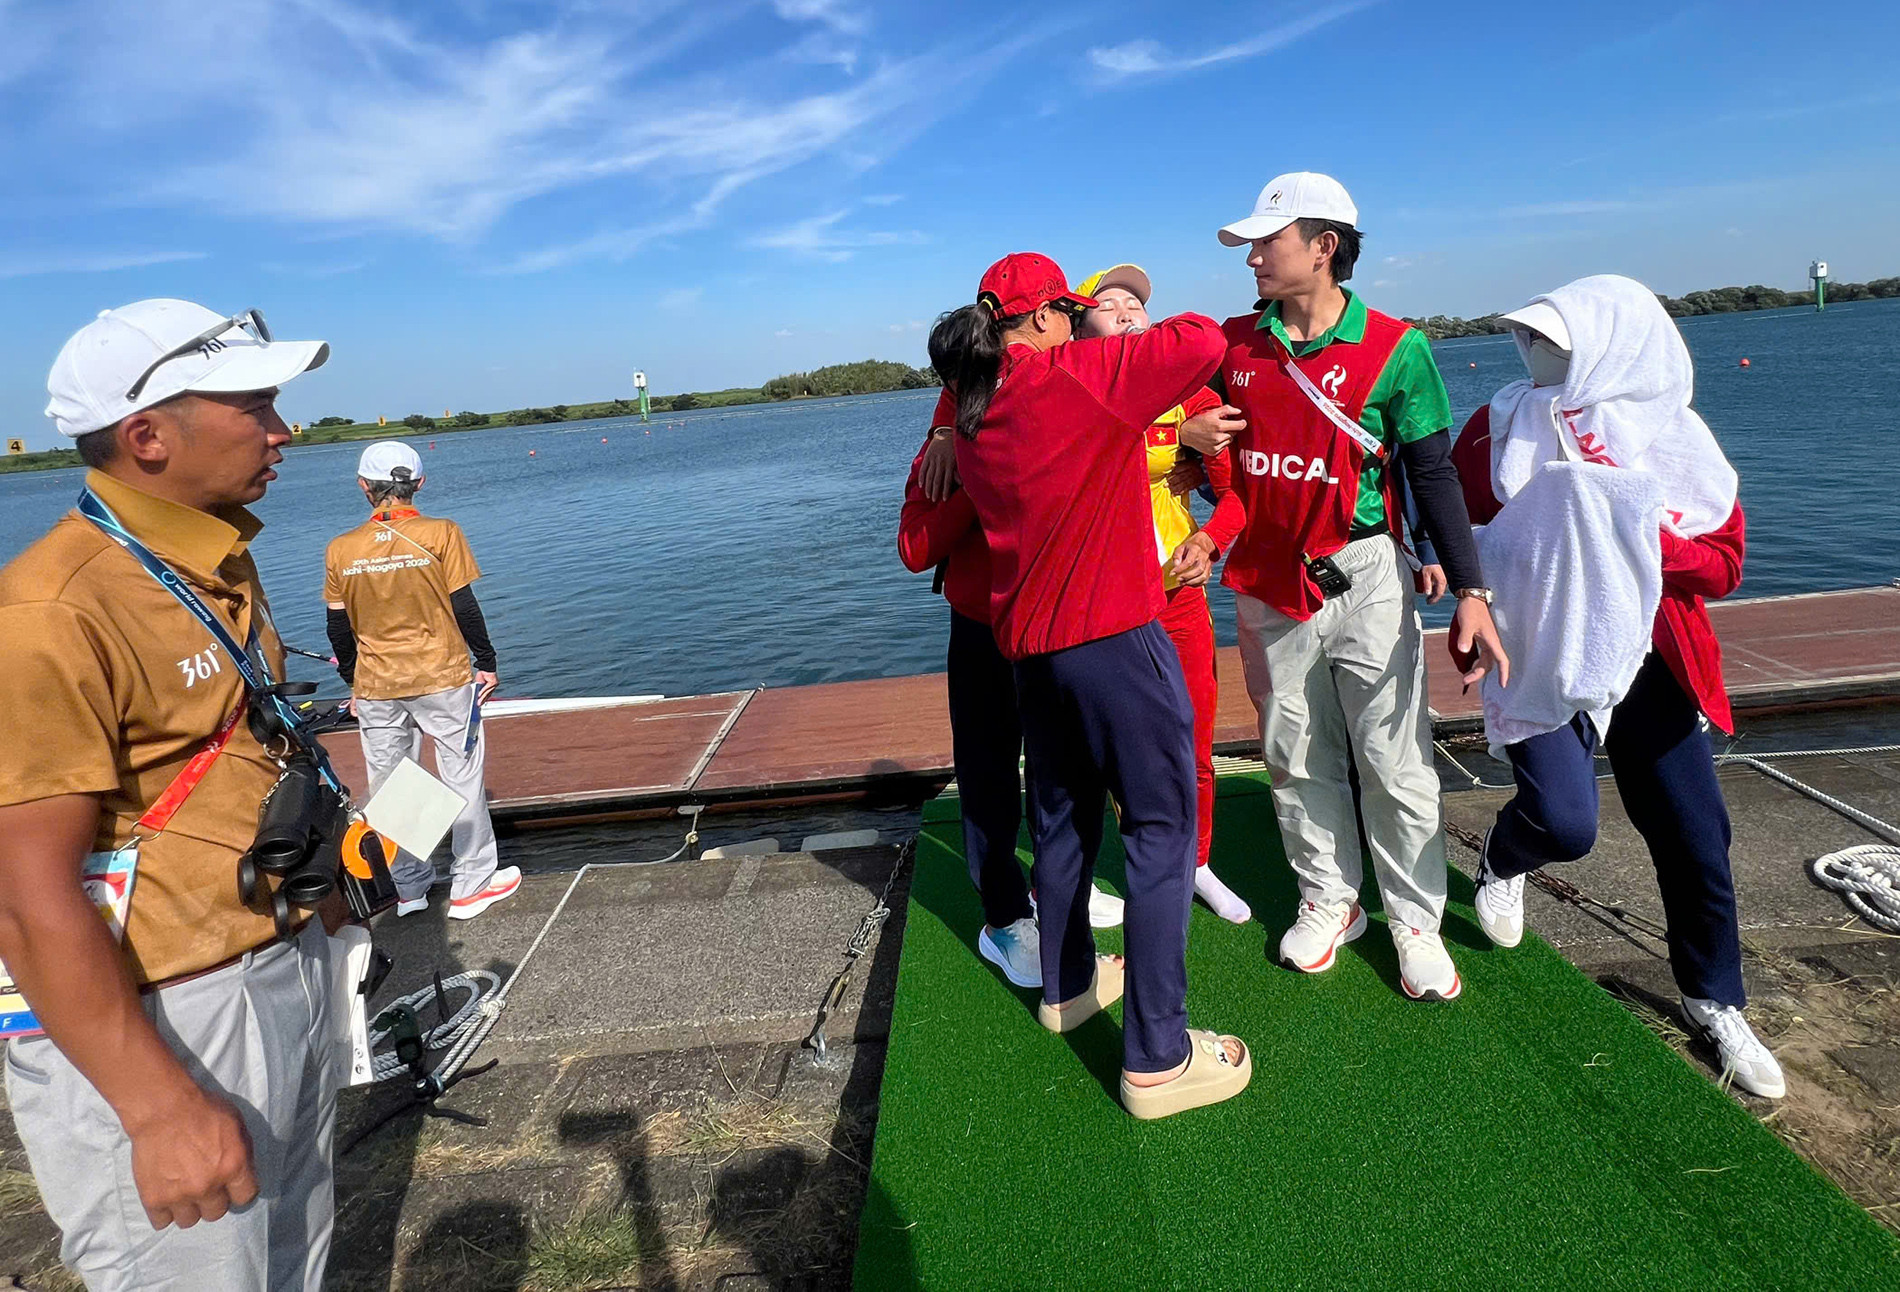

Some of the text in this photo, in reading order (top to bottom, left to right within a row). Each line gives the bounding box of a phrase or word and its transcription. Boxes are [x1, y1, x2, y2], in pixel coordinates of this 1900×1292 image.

[292, 424, 300, 433] 2
[10, 440, 21, 452] 4
[405, 557, 431, 568] 2026
[176, 642, 222, 689] 361°
[2, 1017, 12, 1028] F
